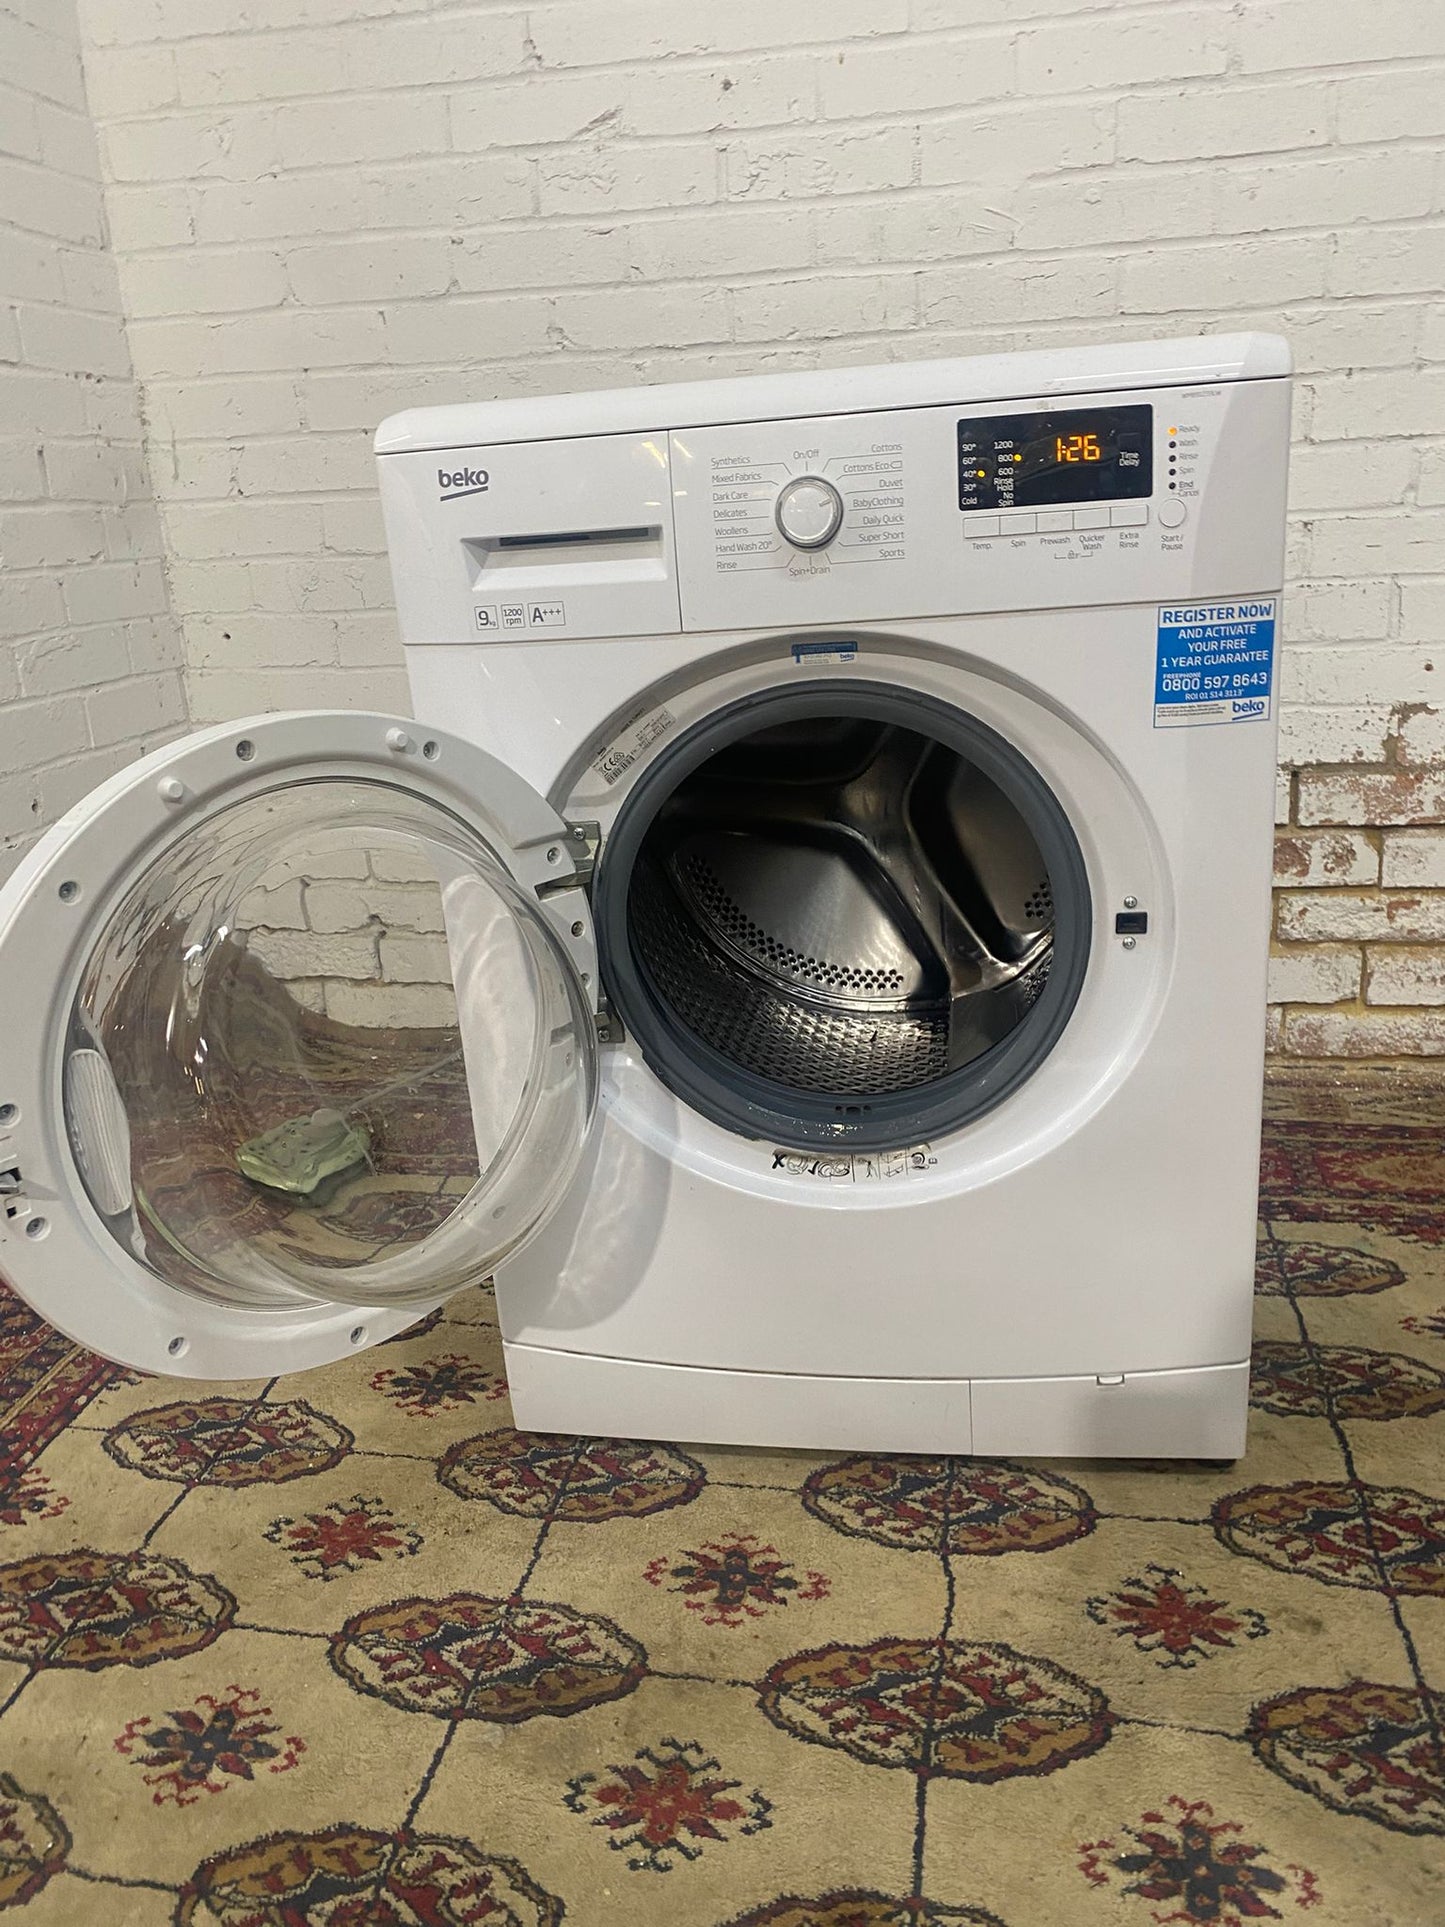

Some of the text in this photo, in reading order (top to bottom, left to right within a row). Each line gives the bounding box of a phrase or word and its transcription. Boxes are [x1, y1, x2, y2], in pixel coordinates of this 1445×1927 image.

[1179, 424, 1200, 433] Ready
[871, 443, 903, 453] Cottons
[962, 442, 976, 452] 90°
[994, 440, 1014, 450] 1200
[1056, 434, 1100, 462] 1:26
[793, 449, 820, 460] On/Off
[998, 454, 1014, 462] 800
[1120, 452, 1140, 460] Time
[711, 456, 751, 468] Synthetics
[962, 456, 976, 465] 60°
[1119, 458, 1140, 467] Delay
[843, 462, 890, 473] Cottons Eco
[998, 467, 1014, 476] 600
[1179, 467, 1194, 475] Spin
[438, 467, 489, 488] beko
[712, 472, 762, 483] Mixed Fabrics
[962, 470, 976, 478] 40°
[880, 479, 903, 488] Duvet
[963, 483, 976, 492] 30°
[996, 482, 1014, 491] Hold
[712, 491, 748, 500] Dark Care
[853, 496, 904, 509] BabyClothing
[962, 496, 977, 505] Cold
[998, 498, 1014, 507] Spin
[714, 509, 748, 518] Delicates
[863, 514, 904, 526] Daily Quick
[714, 527, 749, 536] Woollens
[1120, 532, 1140, 540] Extra
[859, 532, 904, 543] Super Short
[1040, 536, 1070, 546] Prewash
[1079, 534, 1106, 543] Quicker
[716, 544, 734, 552] Hand
[736, 542, 756, 552] Wash
[1011, 540, 1026, 548] Spin
[1083, 542, 1102, 550] Wash
[1119, 540, 1138, 549] Rinse
[1161, 542, 1183, 550] Pause
[880, 548, 905, 558] Sports
[504, 608, 522, 617] 1200
[532, 607, 562, 623] A+++
[1162, 604, 1272, 623] REGISTER NOW
[506, 618, 522, 626] rpm
[1178, 624, 1257, 640] AND ACTIVATE
[1188, 638, 1248, 652] YOUR FREE
[1161, 650, 1270, 668] 1 YEAR GUARANTEE
[1163, 672, 1201, 680] FREEPHONE
[1162, 672, 1268, 692] 0800 597 8643
[1185, 692, 1198, 700] ROI
[1232, 700, 1265, 713] beko
